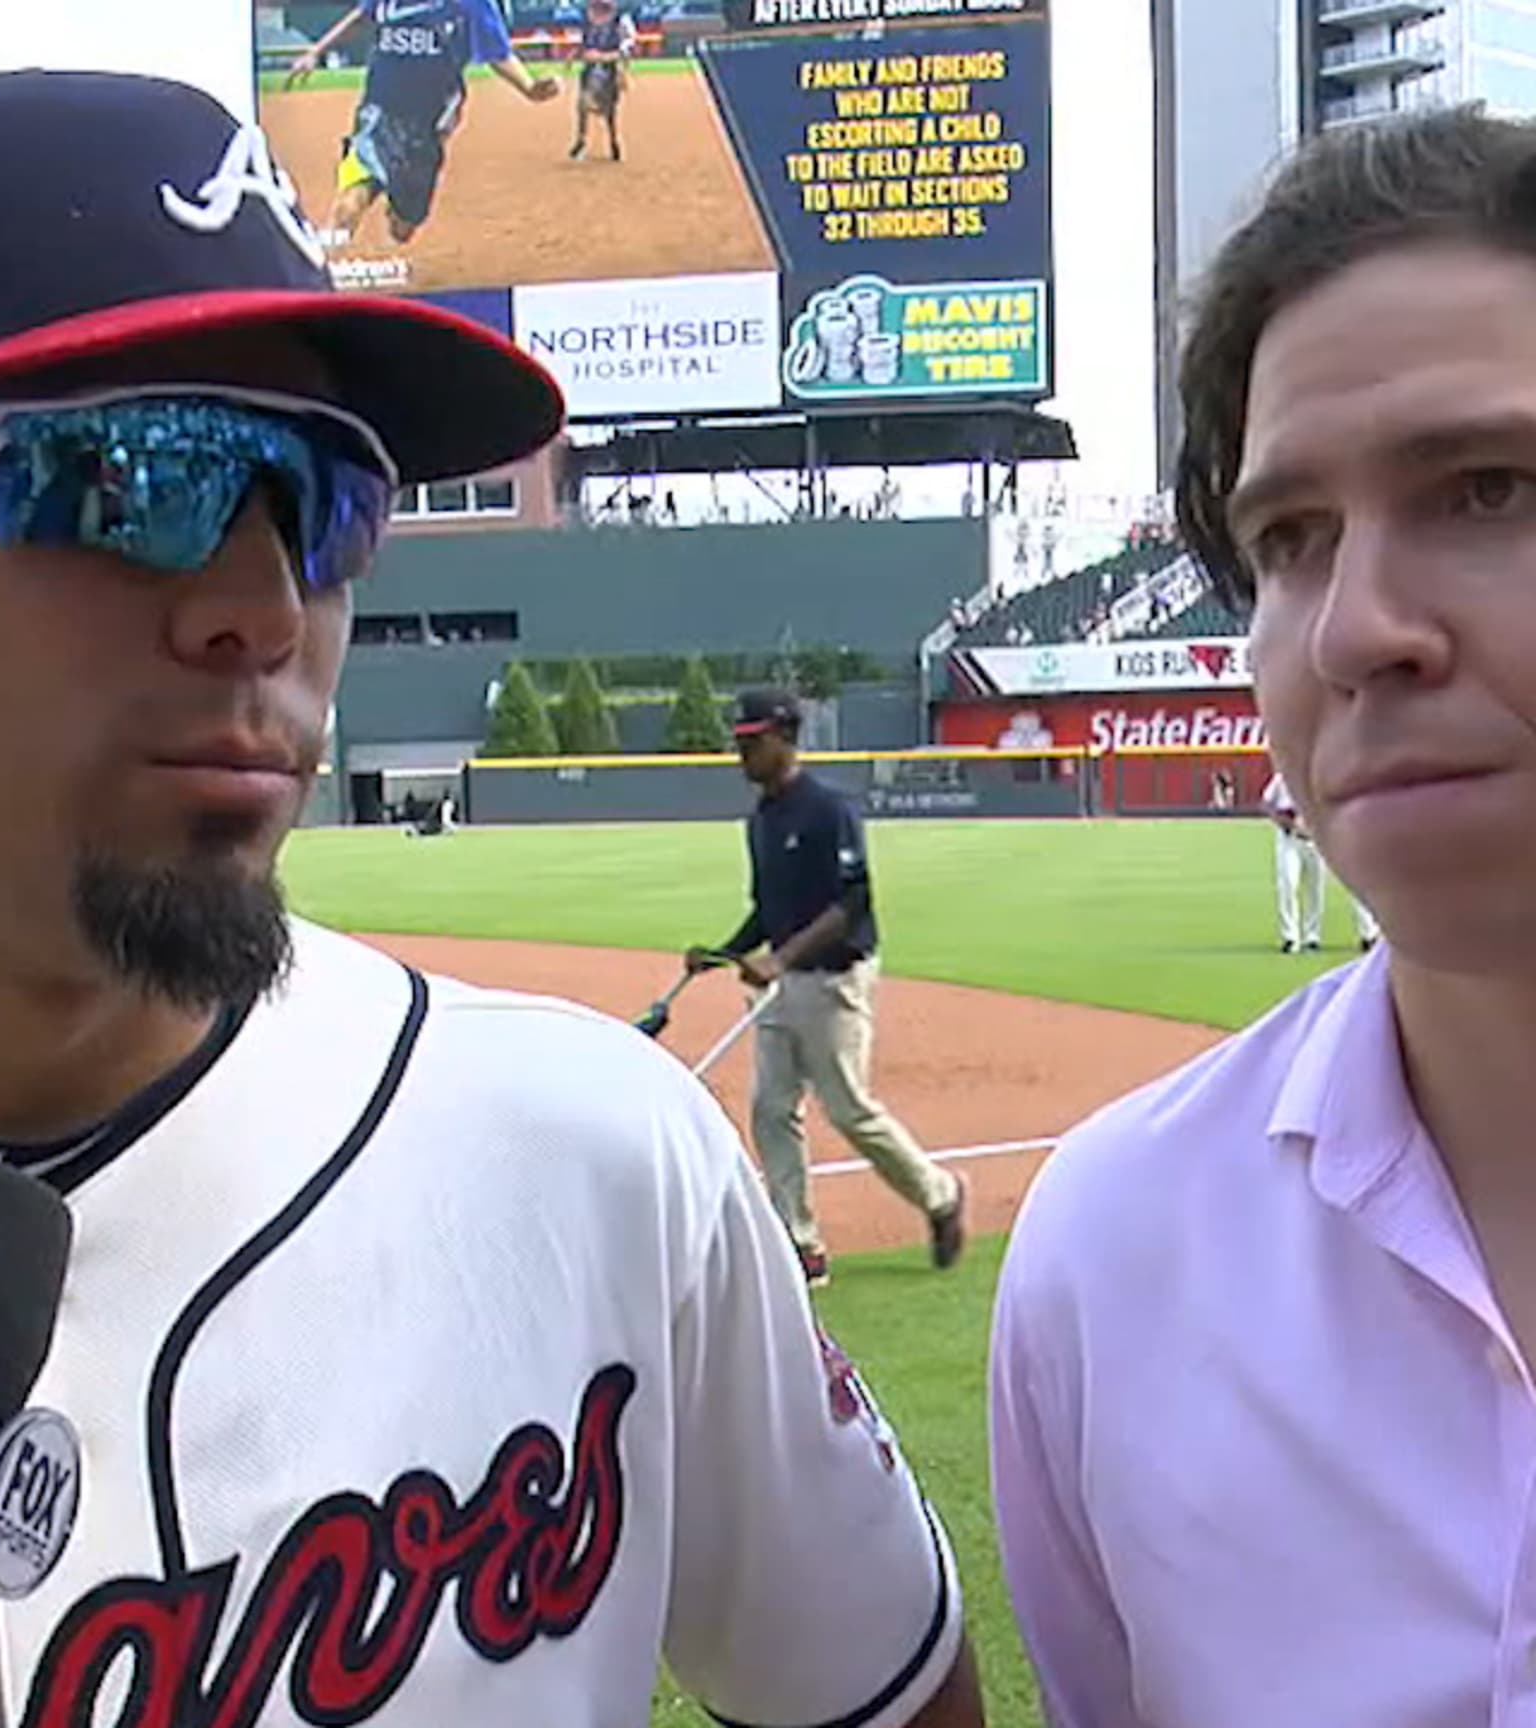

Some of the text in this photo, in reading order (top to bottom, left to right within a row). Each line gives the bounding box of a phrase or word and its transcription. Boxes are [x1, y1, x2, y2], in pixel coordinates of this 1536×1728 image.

[801, 52, 1005, 88] FAMILY AND FRIENDS
[836, 85, 970, 117] WHO ARE NOT
[807, 114, 1001, 149] ESCORTING A CHILD
[786, 143, 1024, 182] TO THE FIELD ARE ASKED
[803, 175, 1008, 211] TO WAIT IN SECTIONS
[824, 213, 852, 242] 32
[857, 209, 950, 239] THROUGH
[904, 292, 1034, 327] MAVIS
[529, 319, 765, 355] NORTHSIDE
[573, 355, 721, 379] HOSPITAL
[924, 354, 1014, 384] TIRE
[1115, 651, 1156, 677] KIDS
[1089, 707, 1188, 756] State
[1, 1437, 71, 1540] FOX
